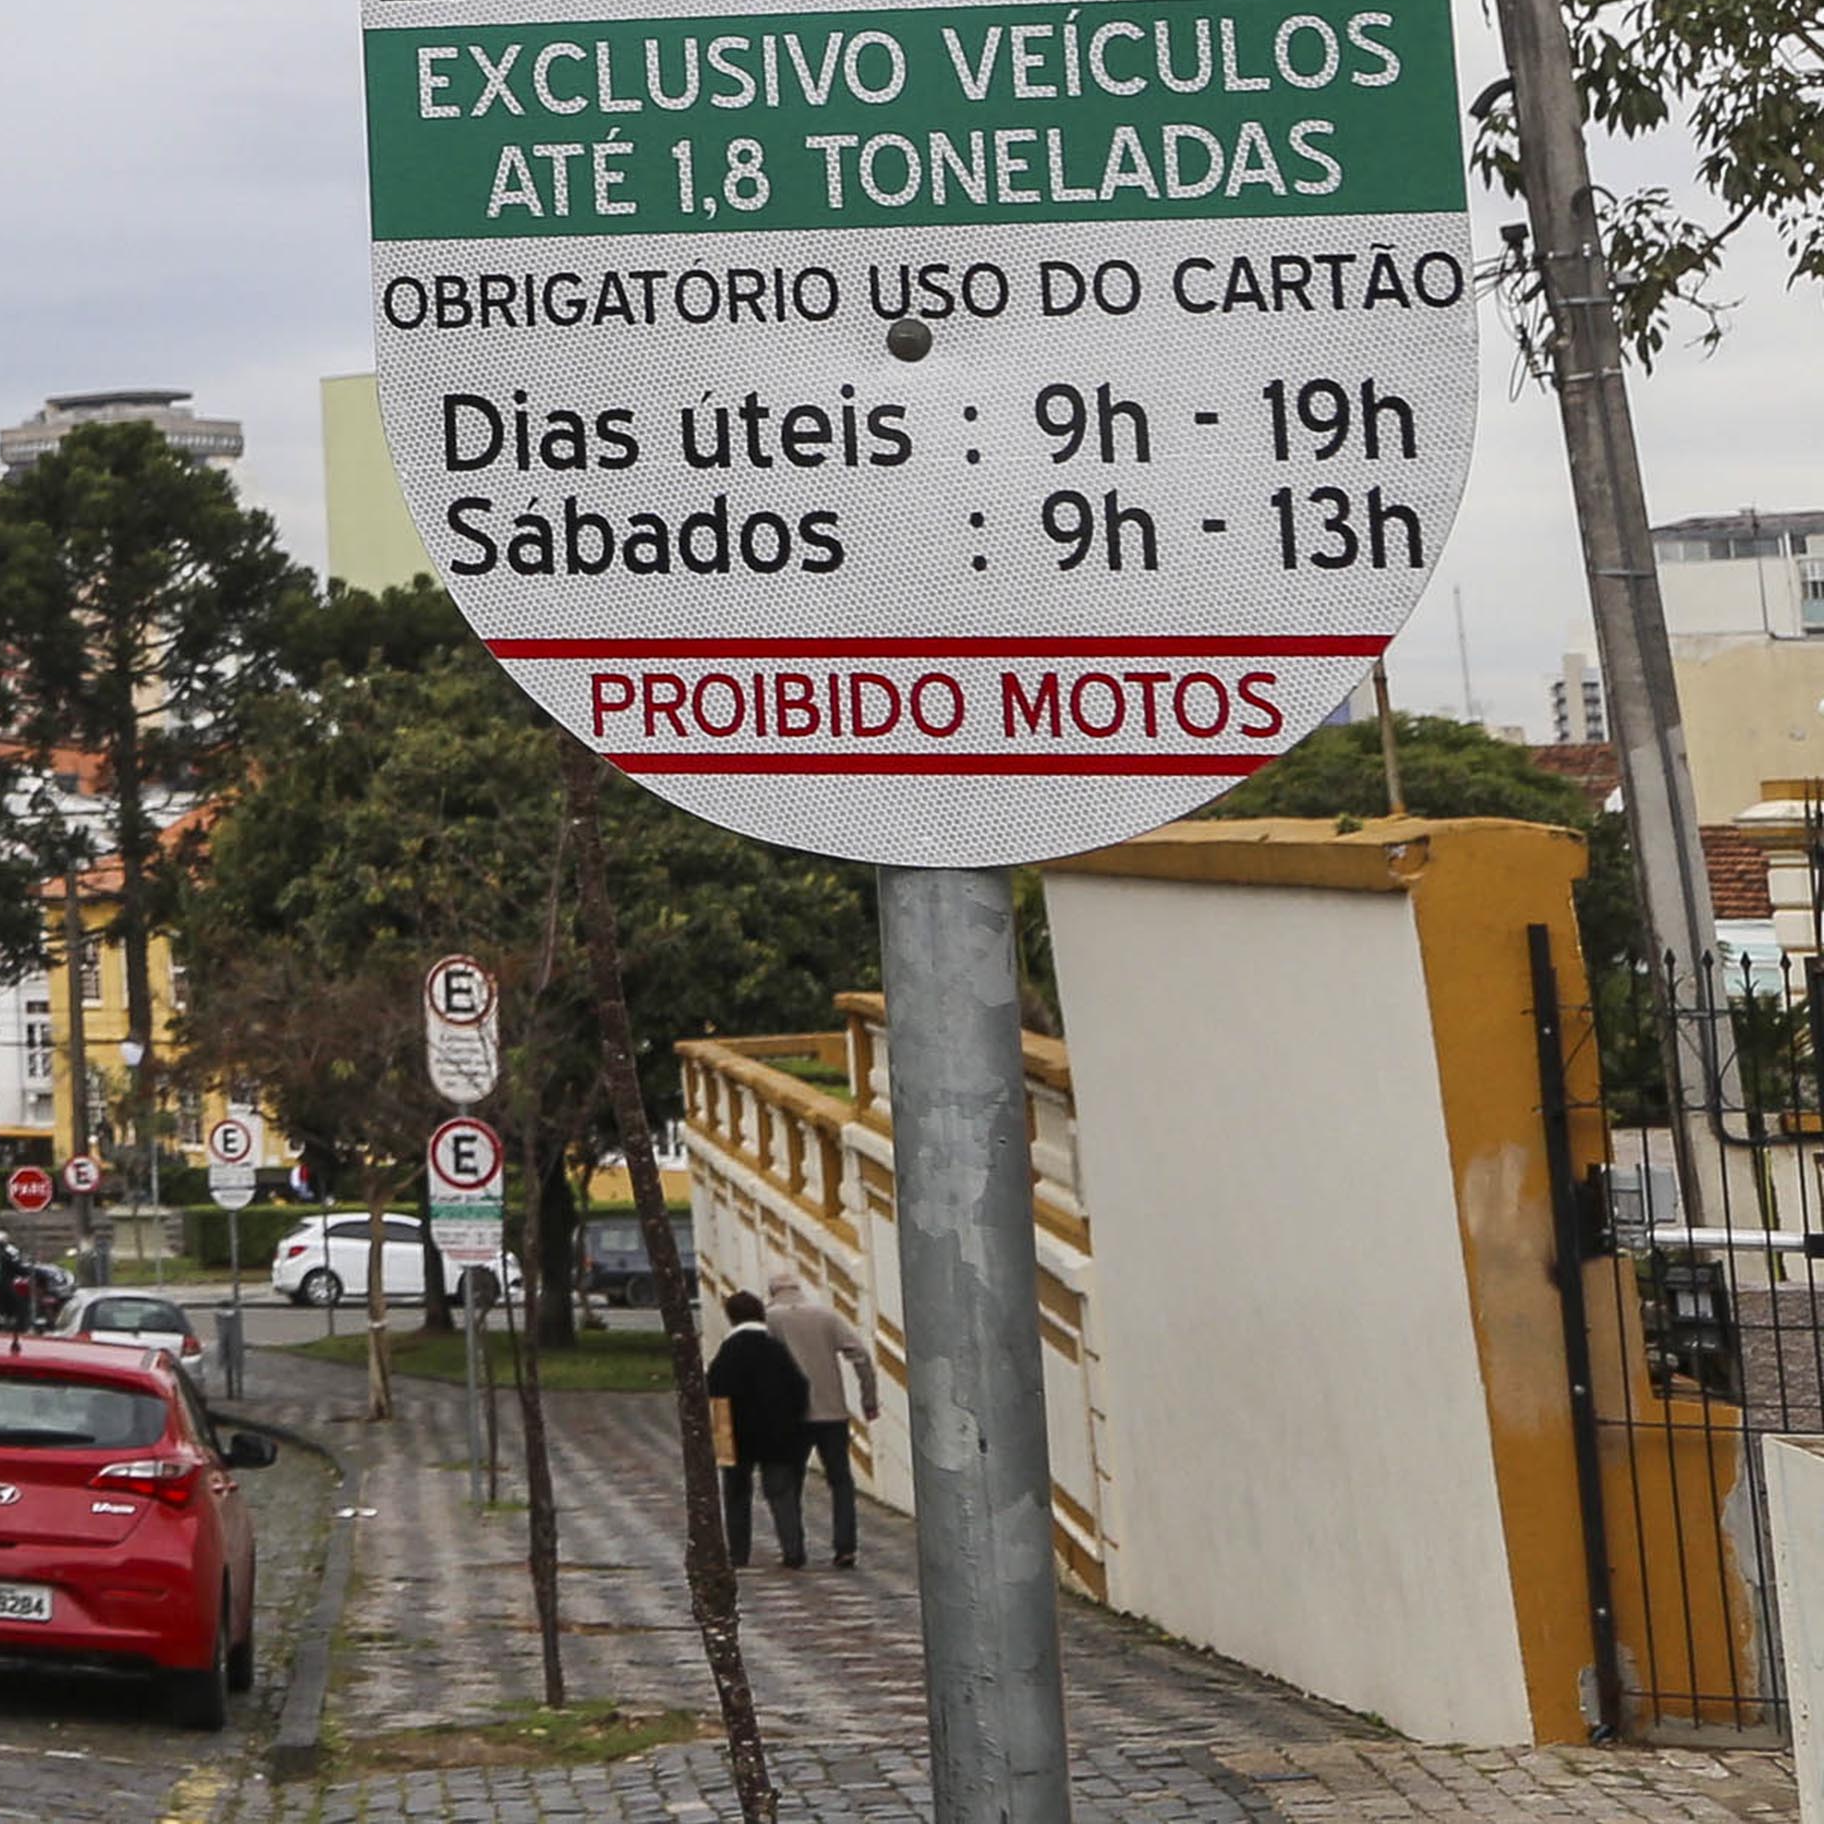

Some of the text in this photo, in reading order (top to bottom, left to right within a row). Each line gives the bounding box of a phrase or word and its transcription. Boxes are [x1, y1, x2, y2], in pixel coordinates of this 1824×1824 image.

[416, 8, 1401, 120] EXCLUSIVO VEÍCULOS
[487, 118, 1343, 218] ATÉ 1,8 TONELADAS
[383, 242, 1464, 330] OBRIGATÓRIO USO DO CARTÃO
[443, 389, 639, 472] Dias
[681, 384, 912, 469] úteis
[1035, 383, 1150, 464] 9h
[1263, 378, 1417, 461] 19h
[447, 494, 845, 576] Sábados
[1041, 490, 1158, 571] 9h
[1271, 486, 1424, 570] 13h
[591, 671, 1284, 739] PROIBIDO MOTOS
[445, 971, 474, 1012] E
[223, 1128, 238, 1153] E
[453, 1135, 478, 1175] E
